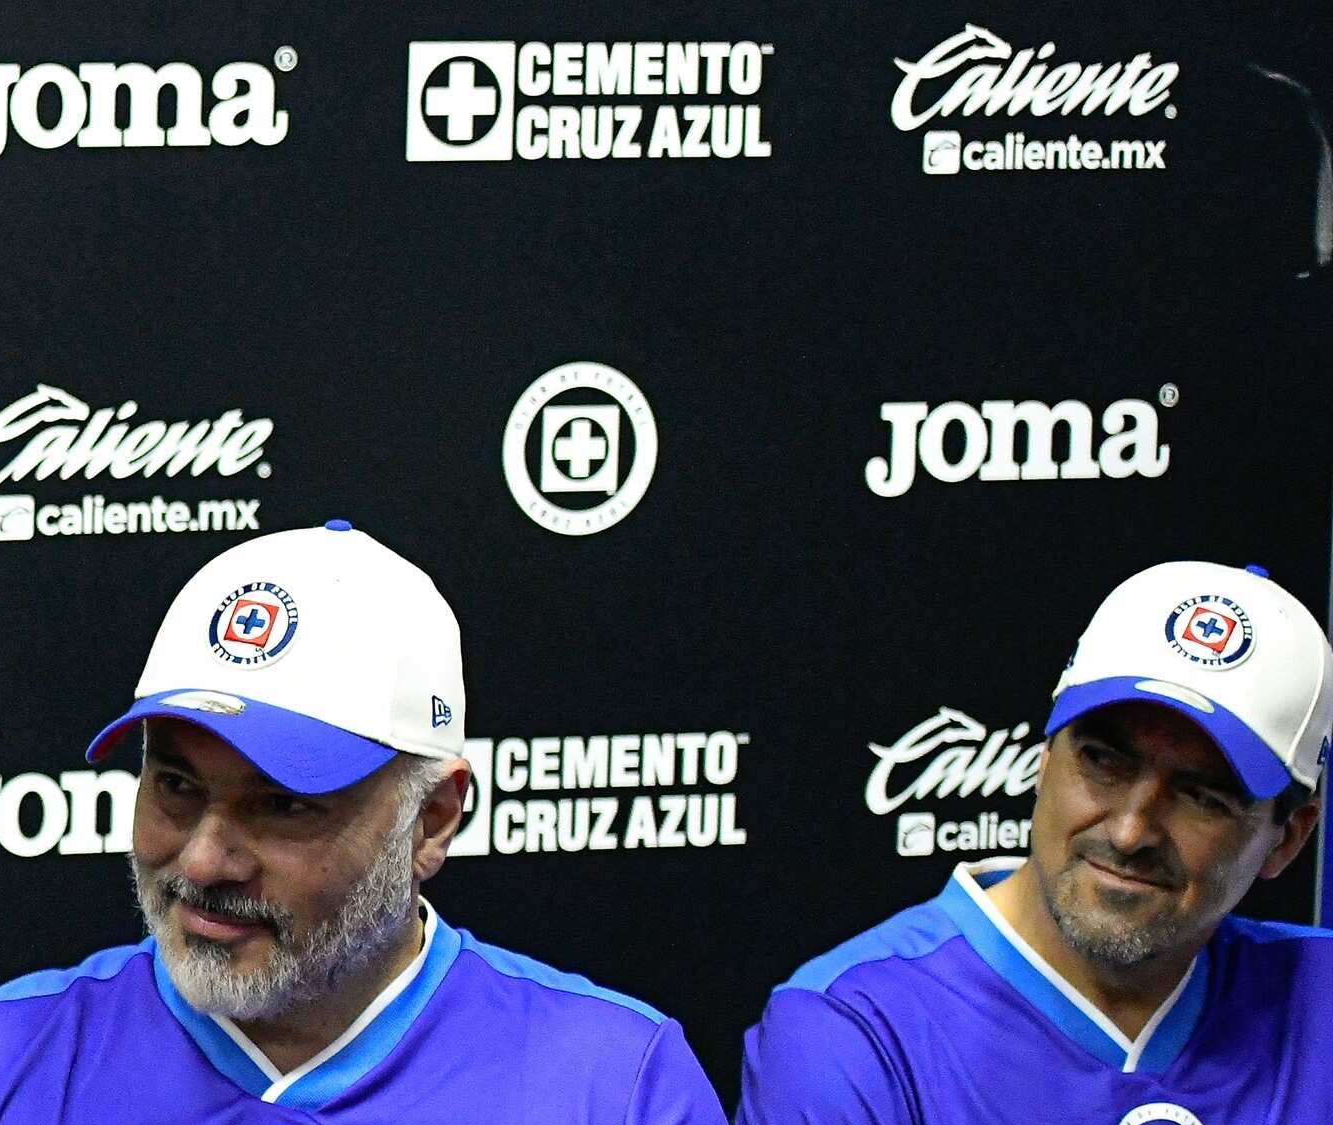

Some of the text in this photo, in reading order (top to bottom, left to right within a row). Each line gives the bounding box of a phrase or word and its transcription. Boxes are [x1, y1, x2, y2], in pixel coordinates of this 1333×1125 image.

[518, 41, 764, 96] CEMENTO
[891, 23, 1179, 131] Caliente
[516, 105, 771, 159] CRUZ AZUL
[963, 132, 1166, 170] caliente.mx
[37, 494, 260, 536] caliente.mx
[496, 731, 738, 792] CEMENTO
[494, 793, 746, 855] CRUZ AZUL
